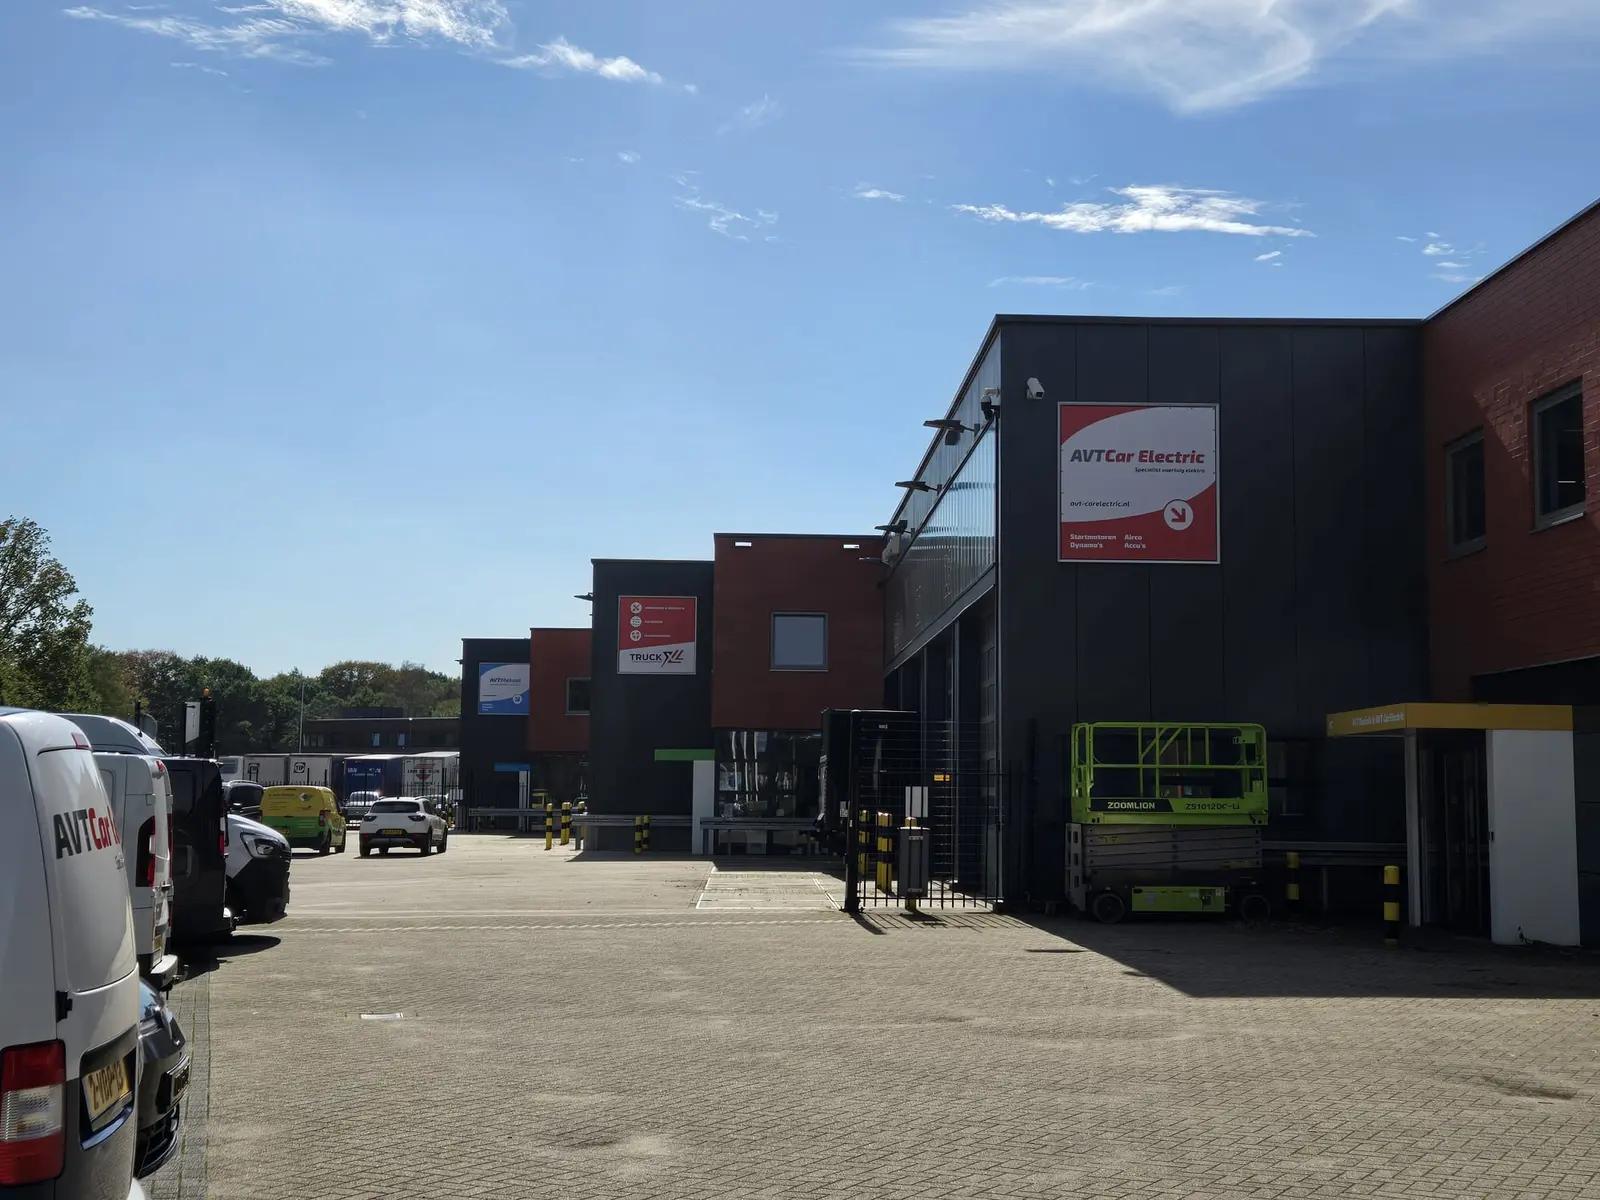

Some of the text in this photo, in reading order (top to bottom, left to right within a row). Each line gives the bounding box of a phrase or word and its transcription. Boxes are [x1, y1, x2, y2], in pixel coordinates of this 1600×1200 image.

[1070, 449, 1205, 464] AVTCar Electric
[1070, 500, 1130, 508] avt-carelectric.nl
[1070, 533, 1117, 541] Startmotoren
[1124, 533, 1143, 541] Airco
[1070, 541, 1103, 549] Dynamo's
[1124, 541, 1146, 549] Accu's
[629, 653, 662, 661] TRUCK
[1107, 801, 1156, 810] ZOOMLION
[53, 807, 112, 860] AVTCar
